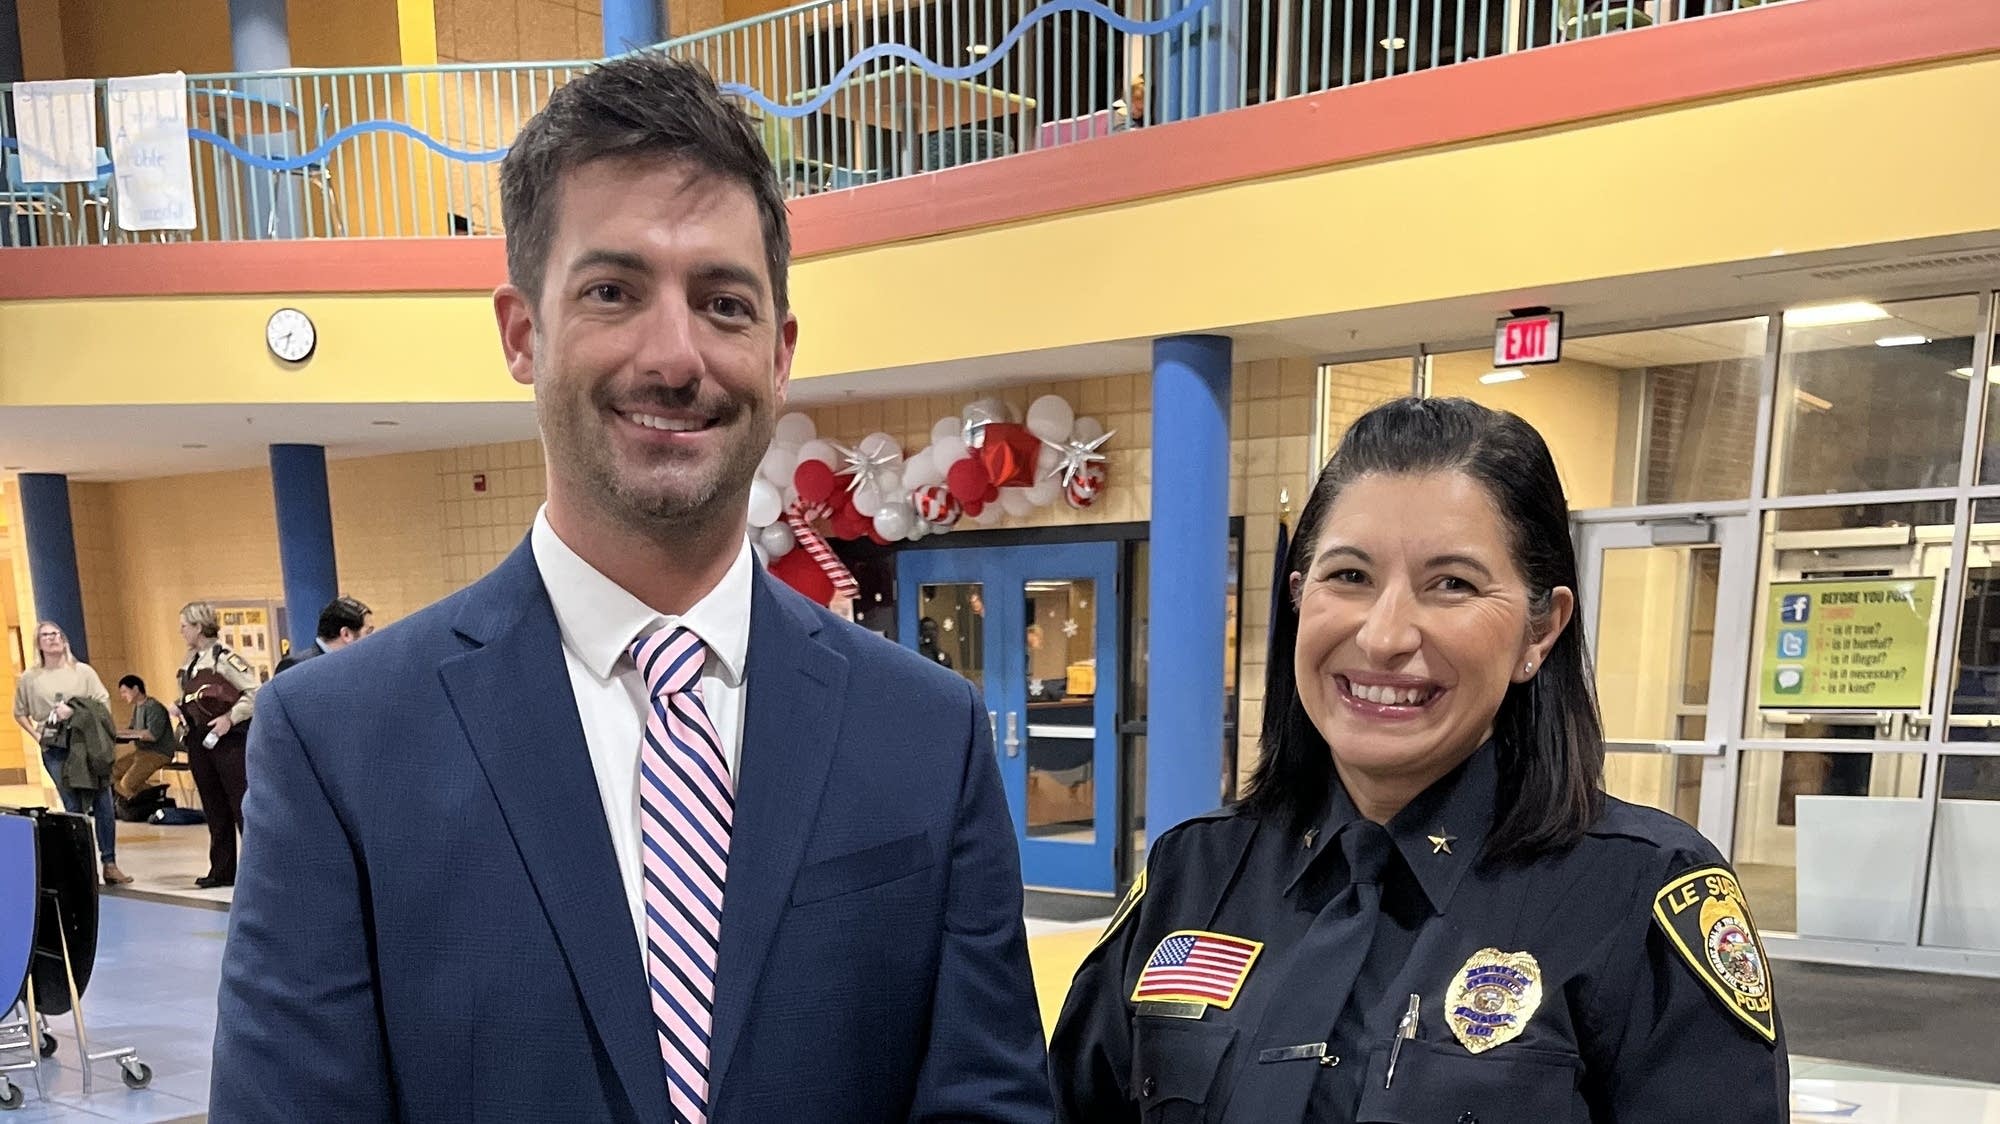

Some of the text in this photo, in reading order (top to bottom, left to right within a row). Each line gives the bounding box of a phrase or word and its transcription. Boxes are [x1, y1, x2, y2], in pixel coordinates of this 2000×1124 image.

[1505, 319, 1550, 360] EXIT
[1821, 592, 1860, 604] BEFORE
[1863, 591, 1884, 603] YOU
[1833, 625, 1842, 634] is
[1844, 624, 1852, 634] it
[1854, 622, 1881, 635] true?
[1832, 640, 1841, 650] is
[1843, 639, 1851, 650] it
[1853, 637, 1893, 650] hurtful?
[1831, 654, 1839, 664] is
[1842, 653, 1850, 664] it
[1851, 652, 1887, 667] illegal?
[1829, 669, 1838, 679] is
[1840, 669, 1848, 678] it
[1849, 667, 1907, 681] necessary?
[1828, 684, 1837, 693] is
[1839, 683, 1847, 693] it
[1848, 682, 1876, 694] kind?
[1667, 882, 1700, 915] LE
